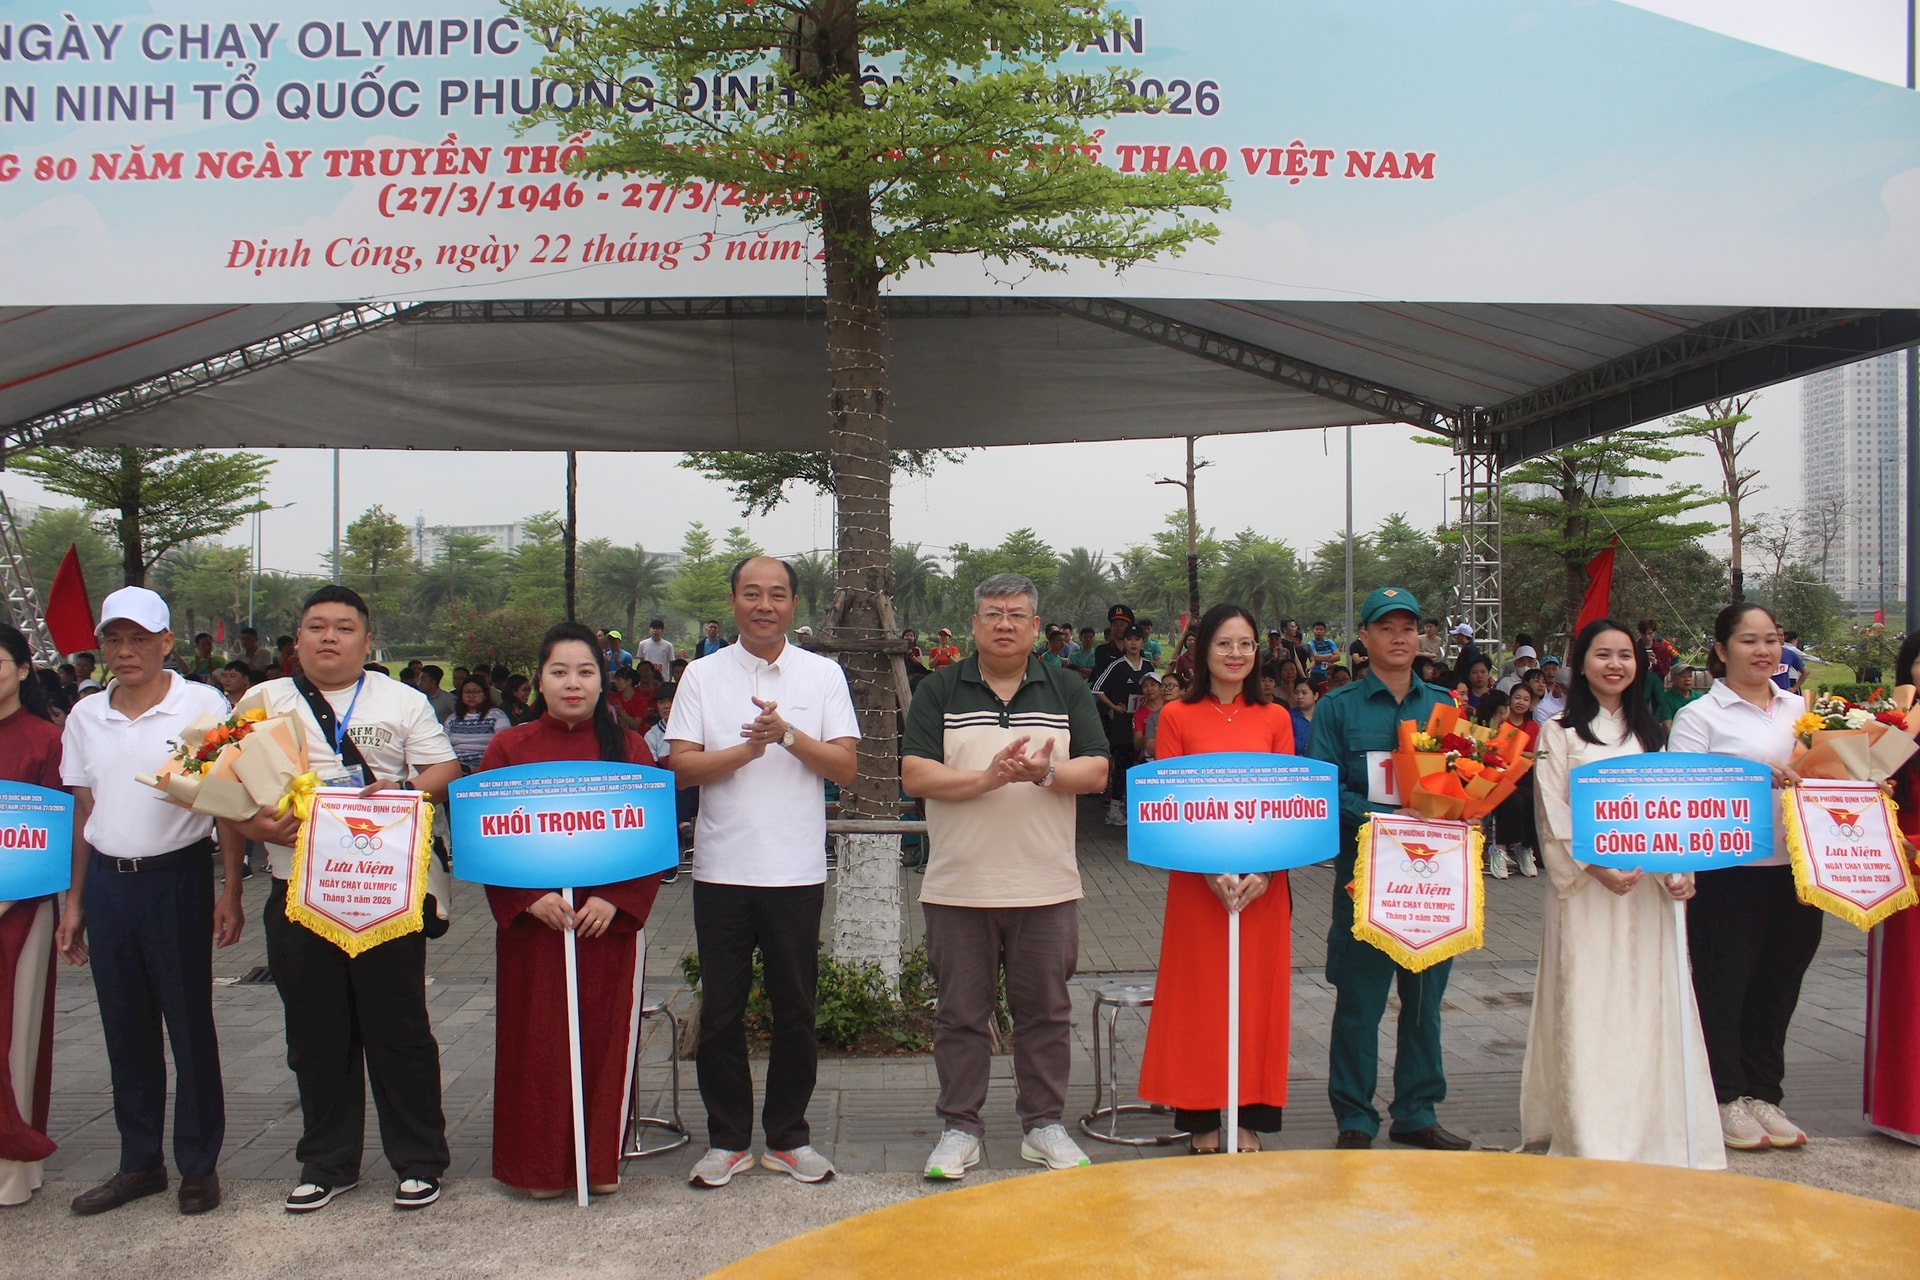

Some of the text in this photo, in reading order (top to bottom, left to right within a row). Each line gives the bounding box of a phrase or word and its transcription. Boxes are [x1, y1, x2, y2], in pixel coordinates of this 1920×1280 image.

[142, 22, 279, 67] CHẠY
[297, 19, 520, 59] OLYMPIC
[56, 85, 174, 121] NINH
[193, 62, 258, 119] TỔ
[276, 65, 420, 119] QUỐC
[1112, 79, 1220, 115] 2026
[34, 155, 77, 181] 80
[88, 144, 183, 181] NĂM
[195, 142, 312, 180] NGÀY
[323, 132, 491, 178] TRUYỀN
[1116, 145, 1227, 174] THAO
[1240, 140, 1335, 184] VIỆT
[1345, 151, 1435, 180] NAM
[378, 182, 584, 217] (27/3/1946
[225, 237, 309, 277] Định
[325, 237, 423, 273] Công,
[435, 240, 519, 278] ngày
[529, 234, 571, 263] 22
[581, 232, 683, 270] tháng
[693, 232, 713, 262] 3
[725, 231, 801, 261] năm
[482, 804, 644, 836] KHỐI TRỌNG TÀI
[1140, 794, 1327, 824] KHỐI QUÂN SỰ PHƯỜNG
[1596, 794, 1749, 822] KHỐI CÁC ĐƠN VỊ
[1596, 828, 1751, 856] CÔNG AN, BỘ ĐỘI
[1826, 846, 1882, 860] Lưu Niệm
[325, 859, 394, 877] Lưu Niệm
[319, 878, 398, 891] NGÀY CHẠY OLYMPIC
[1387, 882, 1451, 898] Lưu Niệm
[323, 894, 345, 903] Tháng
[354, 895, 370, 903] năm
[373, 896, 392, 904] 2026
[1382, 899, 1455, 910] NGÀY CHẠY OLYMPIC
[1386, 912, 1406, 921] Tháng
